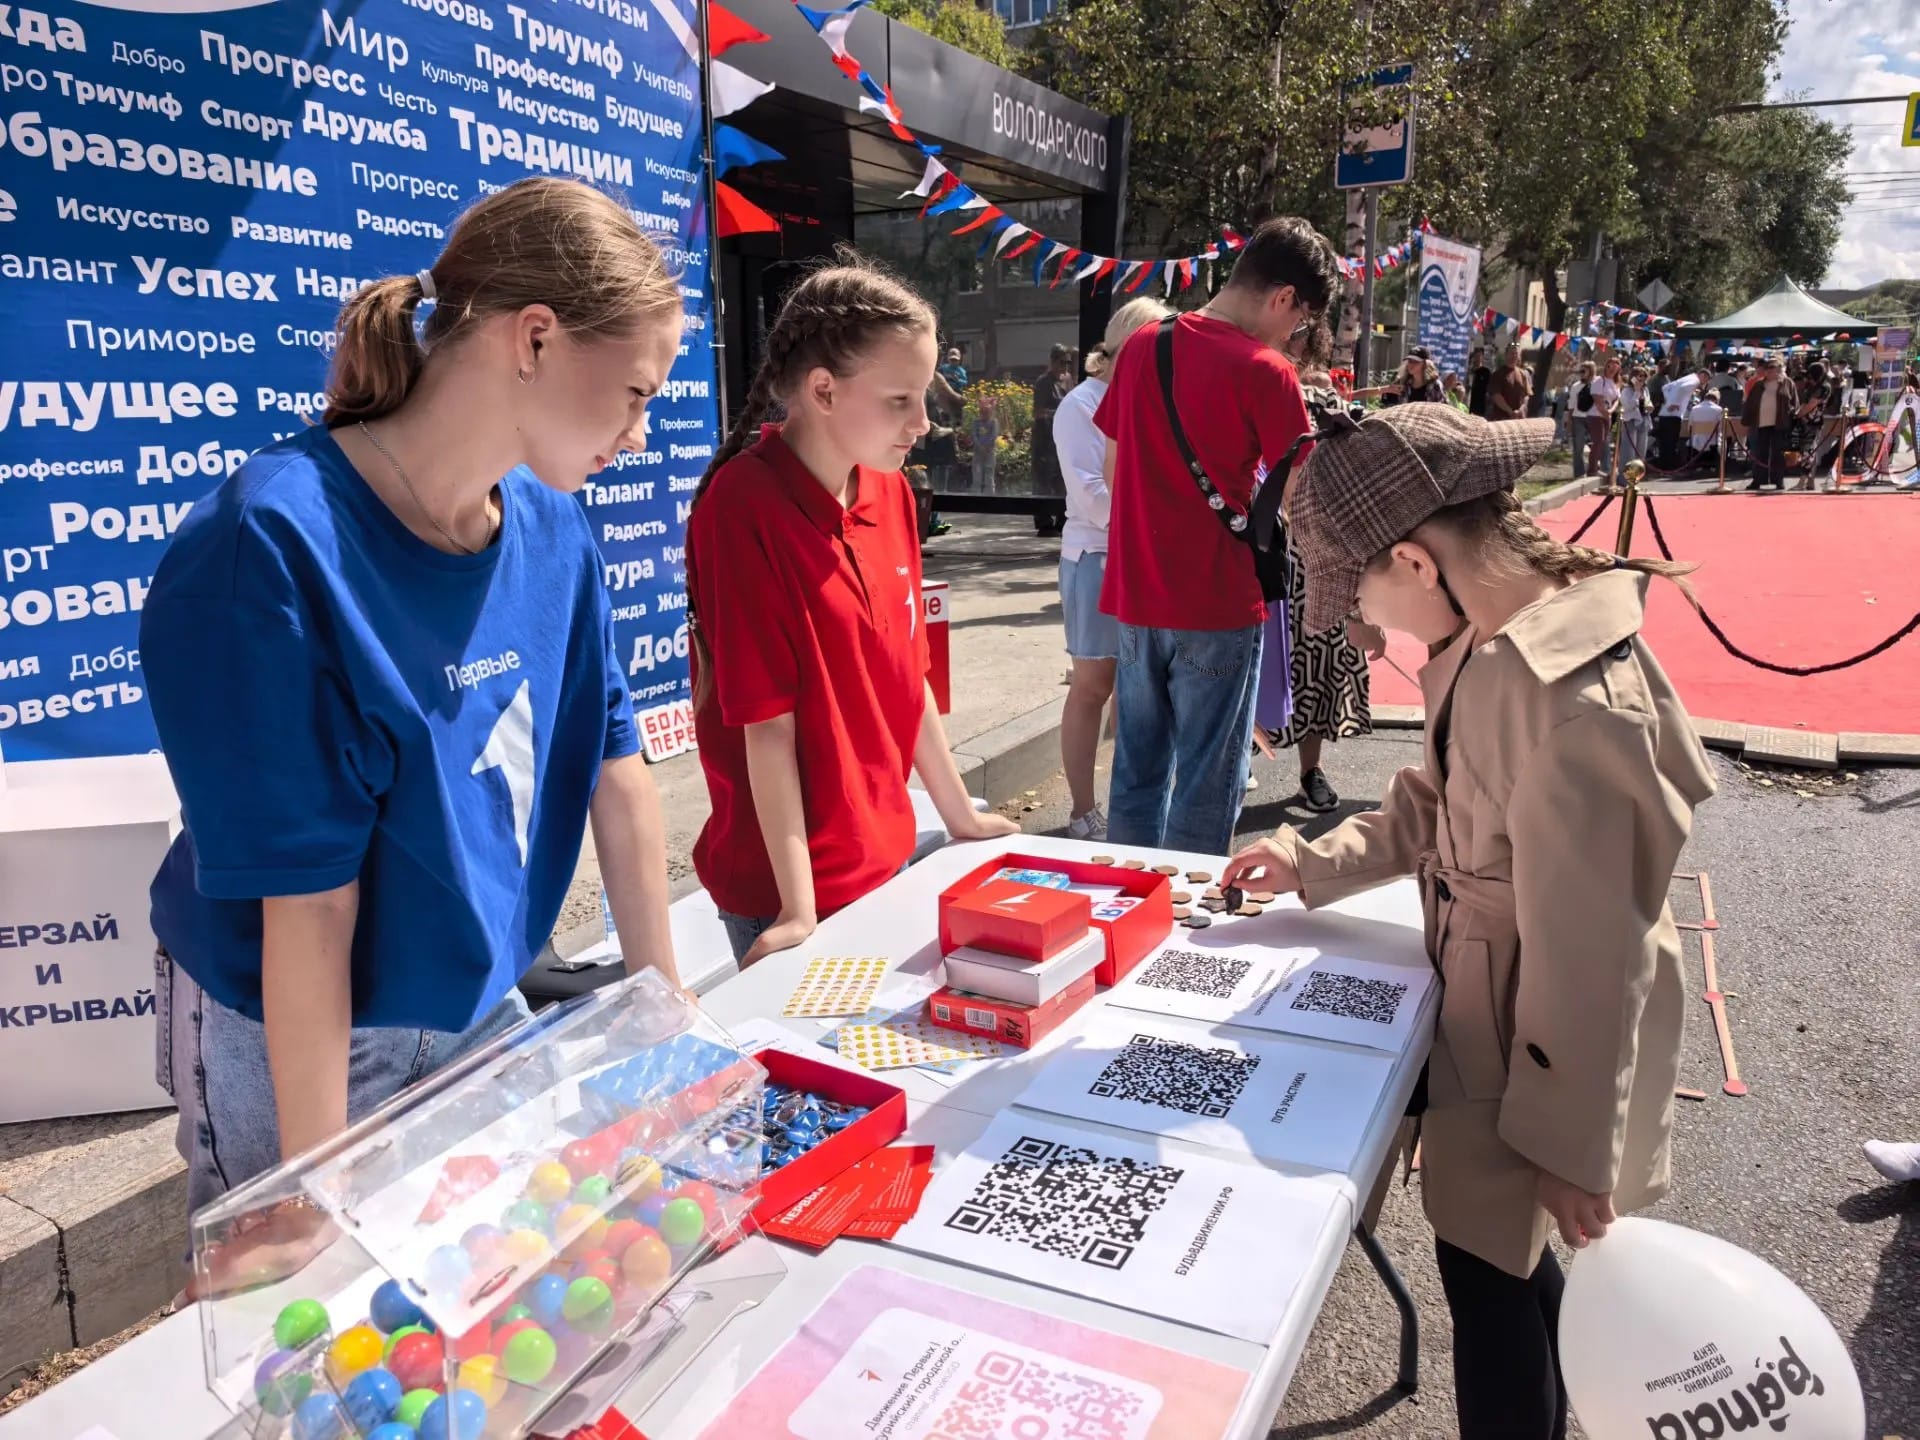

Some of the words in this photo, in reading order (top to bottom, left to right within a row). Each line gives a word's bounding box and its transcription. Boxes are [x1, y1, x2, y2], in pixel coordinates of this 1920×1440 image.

[112, 41, 186, 74] Добро
[321, 9, 409, 73] Мир
[507, 4, 624, 79] Триумф
[200, 29, 367, 97] Прогресс
[421, 60, 489, 94] Культура
[474, 43, 596, 101] Профессия
[632, 61, 694, 101] Учитель
[53, 70, 183, 122] Триумф
[378, 82, 438, 116] Честь
[497, 87, 600, 135] Искусство
[200, 100, 294, 141] Спорт
[302, 99, 428, 151] Дружба
[604, 95, 684, 140] Будущее
[993, 92, 1107, 172] ВОЛОДАРСКОГО
[0, 111, 318, 197] бразование
[449, 106, 634, 187] Традиции
[351, 162, 459, 201] Прогресс
[645, 157, 698, 185] Искусство
[56, 196, 210, 235] Искусство
[661, 190, 691, 210] Добро
[230, 215, 353, 250] Развитие
[356, 208, 444, 241] Радость
[0, 253, 118, 285] алант
[661, 247, 702, 266] огресс
[131, 255, 279, 302] Успех
[65, 318, 256, 359] Приморье
[656, 380, 709, 402] ергия
[660, 418, 704, 432] Профессия
[0, 458, 124, 484] рофессия
[669, 443, 712, 460] Родина
[582, 481, 655, 507] Талант
[603, 520, 668, 543] Радость
[444, 650, 521, 691] Первые
[0, 681, 143, 730] овесть
[650, 725, 697, 755] ПЕРЕ
[0, 912, 119, 948] ЕРЗАЙ
[35, 963, 62, 986] И
[0, 988, 156, 1028] КРЫВАЙ
[1270, 1107, 1288, 1124] ПУТЬ
[1280, 1072, 1307, 1107] УЧАСТНИКА
[1174, 1186, 1233, 1276] БУДЬВДВИЖЕНИИ.РФ
[914, 1345, 955, 1394] городской
[1693, 1341, 1719, 1362] ЦЕНТР
[864, 1381, 909, 1431] Движение
[903, 1346, 937, 1381] Первых
[1644, 1353, 1726, 1393] РАЗВЛЕКАТЕЛЬНЫЙ
[1684, 1364, 1733, 1394] СПОРТИВНО
